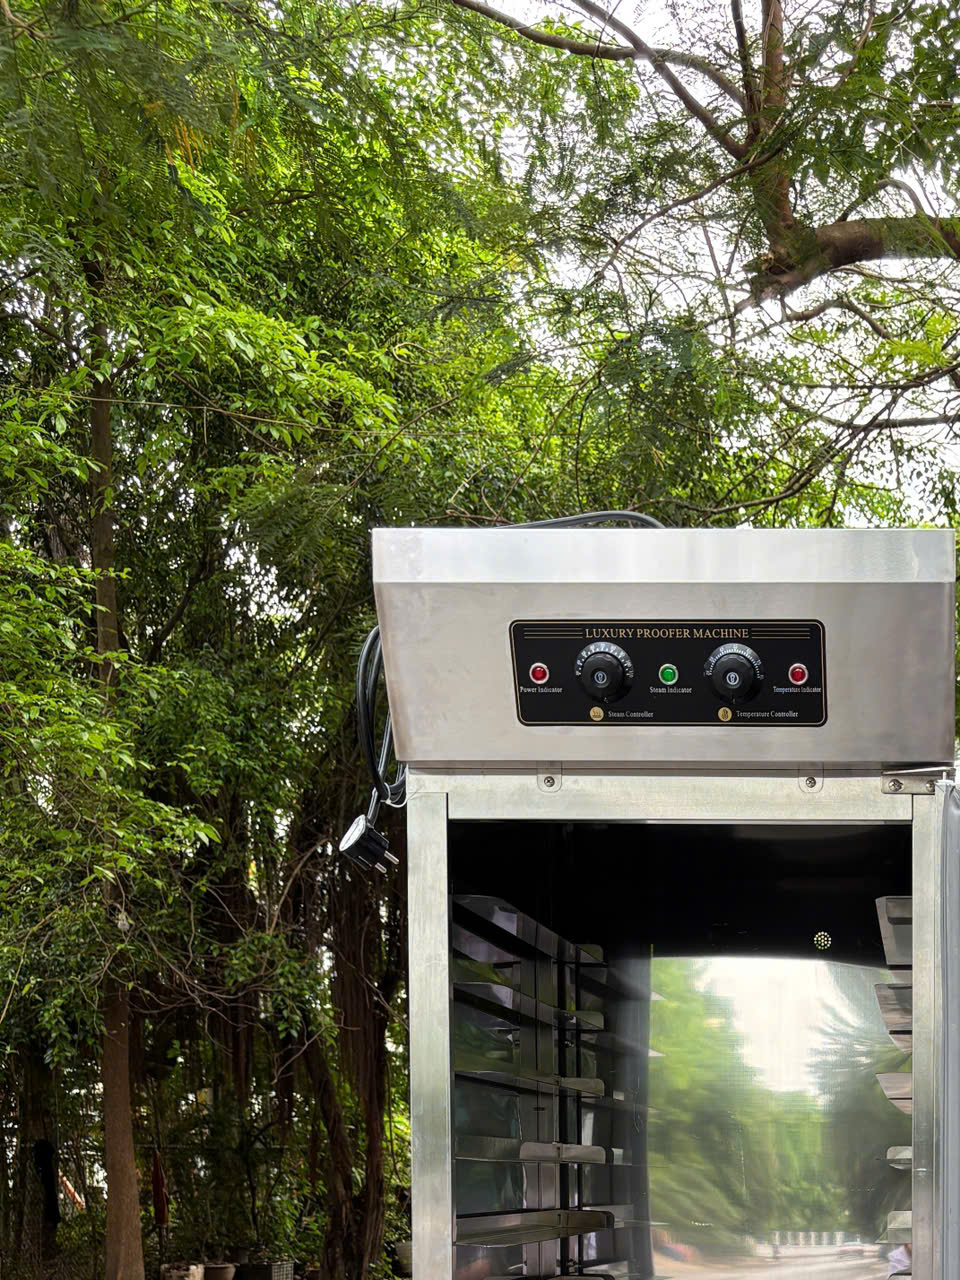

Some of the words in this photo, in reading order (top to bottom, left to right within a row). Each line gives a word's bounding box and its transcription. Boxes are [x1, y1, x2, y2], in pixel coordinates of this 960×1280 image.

[585, 628, 634, 639] LUXURY
[636, 628, 691, 639] PROOFER
[693, 628, 749, 639] MACHINE
[649, 686, 667, 694] Steam
[667, 686, 692, 694] Indicator
[773, 686, 800, 694] Temperature
[608, 710, 625, 718] Steam
[625, 710, 654, 718] Controller
[736, 710, 770, 719] Temperature
[770, 710, 799, 718] Controller
